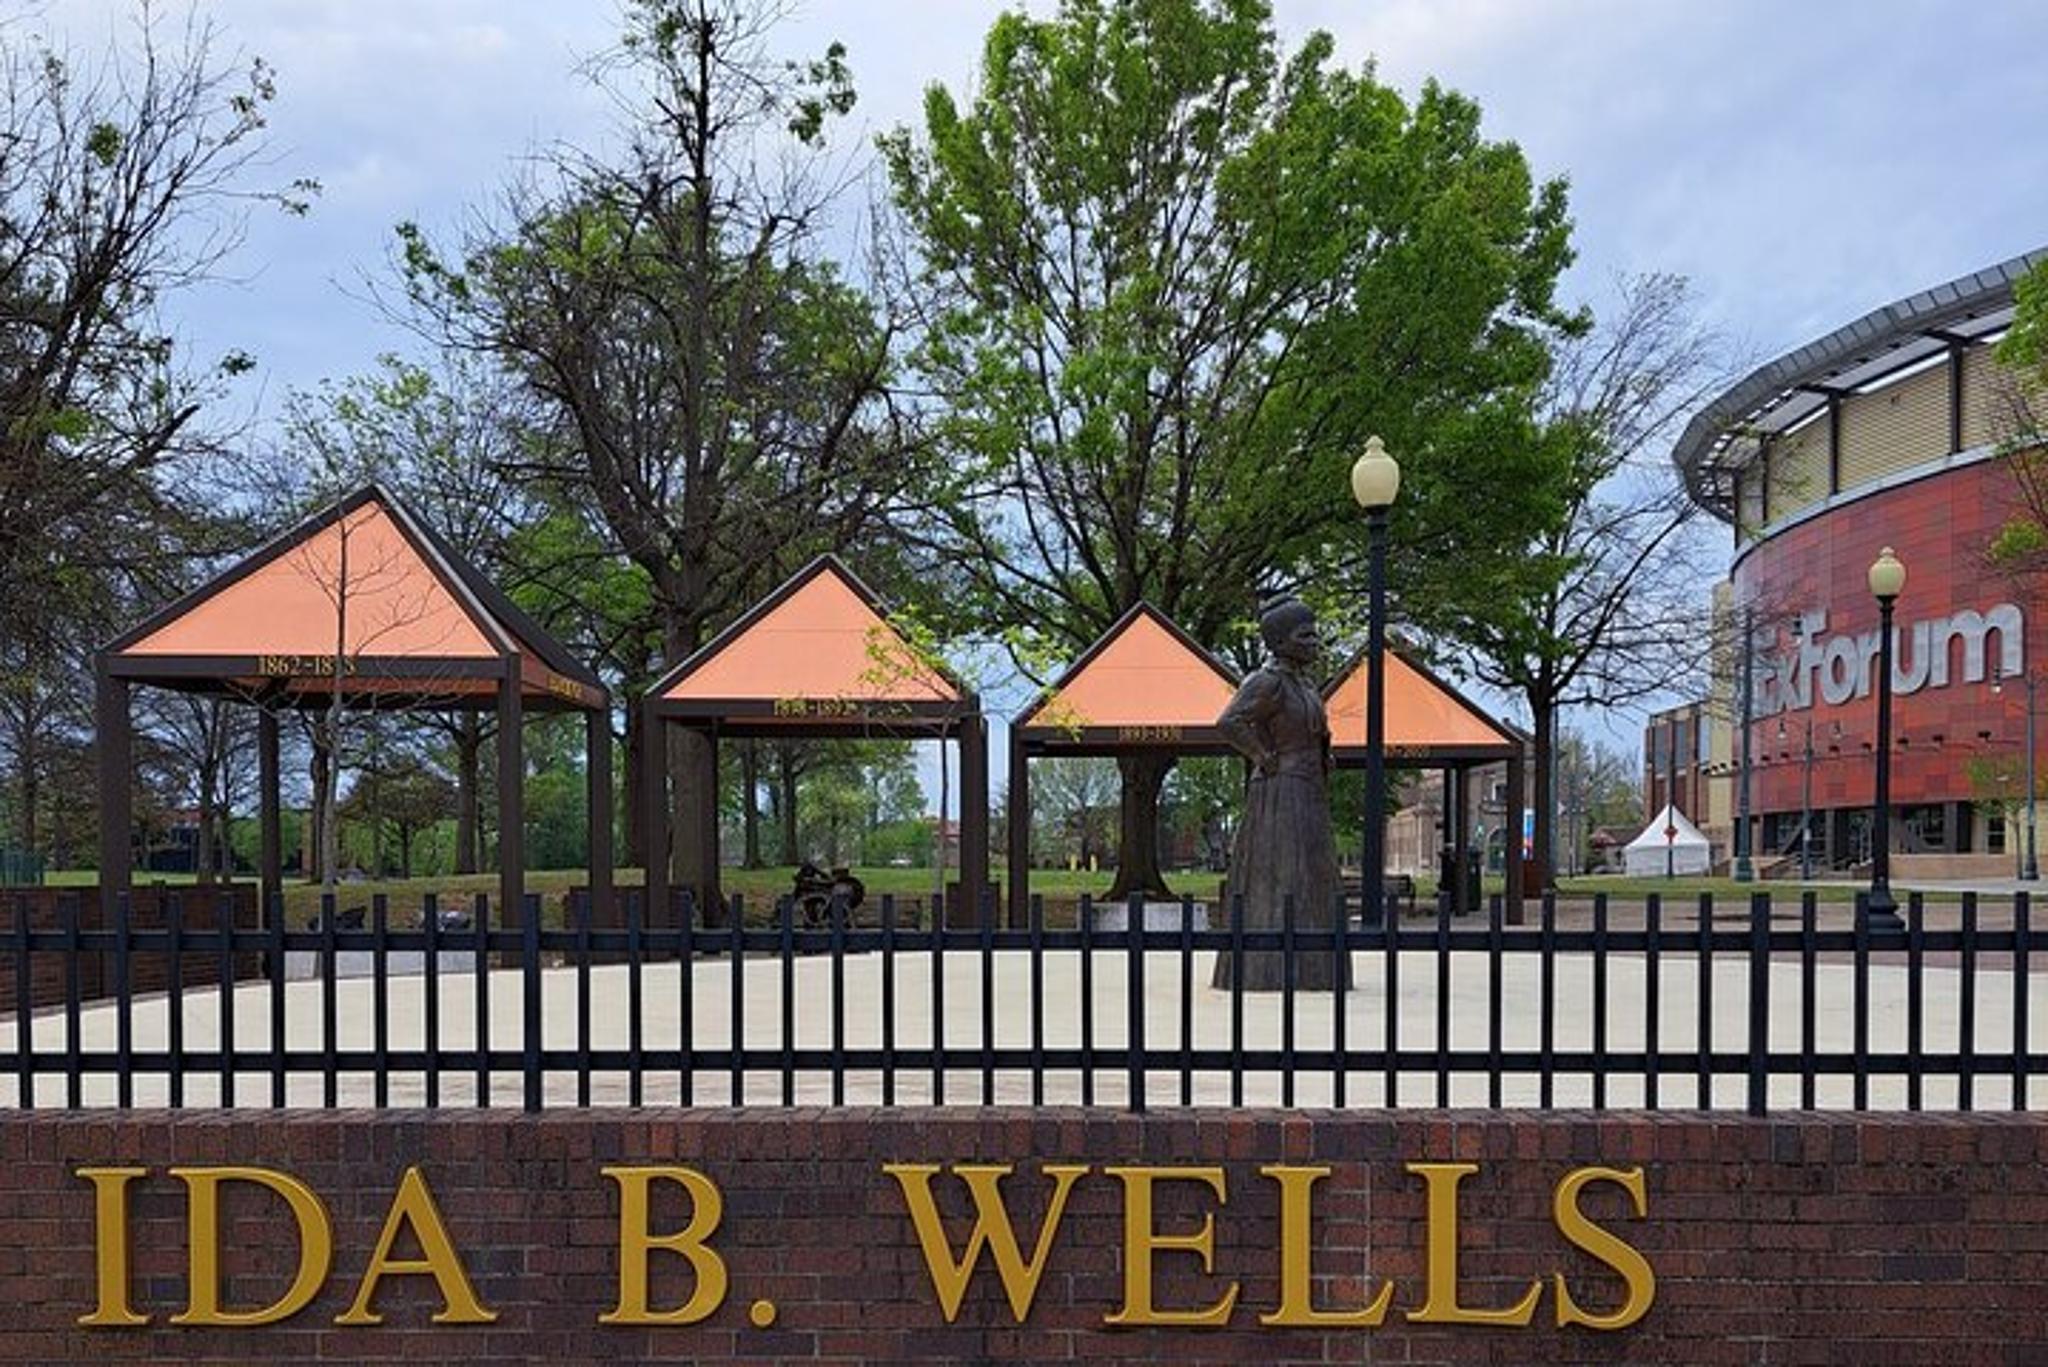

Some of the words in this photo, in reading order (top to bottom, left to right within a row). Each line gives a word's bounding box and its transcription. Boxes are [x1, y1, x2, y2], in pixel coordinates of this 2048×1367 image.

[75, 1165, 500, 1327] IDA
[598, 1165, 777, 1327] B.
[882, 1163, 1658, 1331] WELLS
